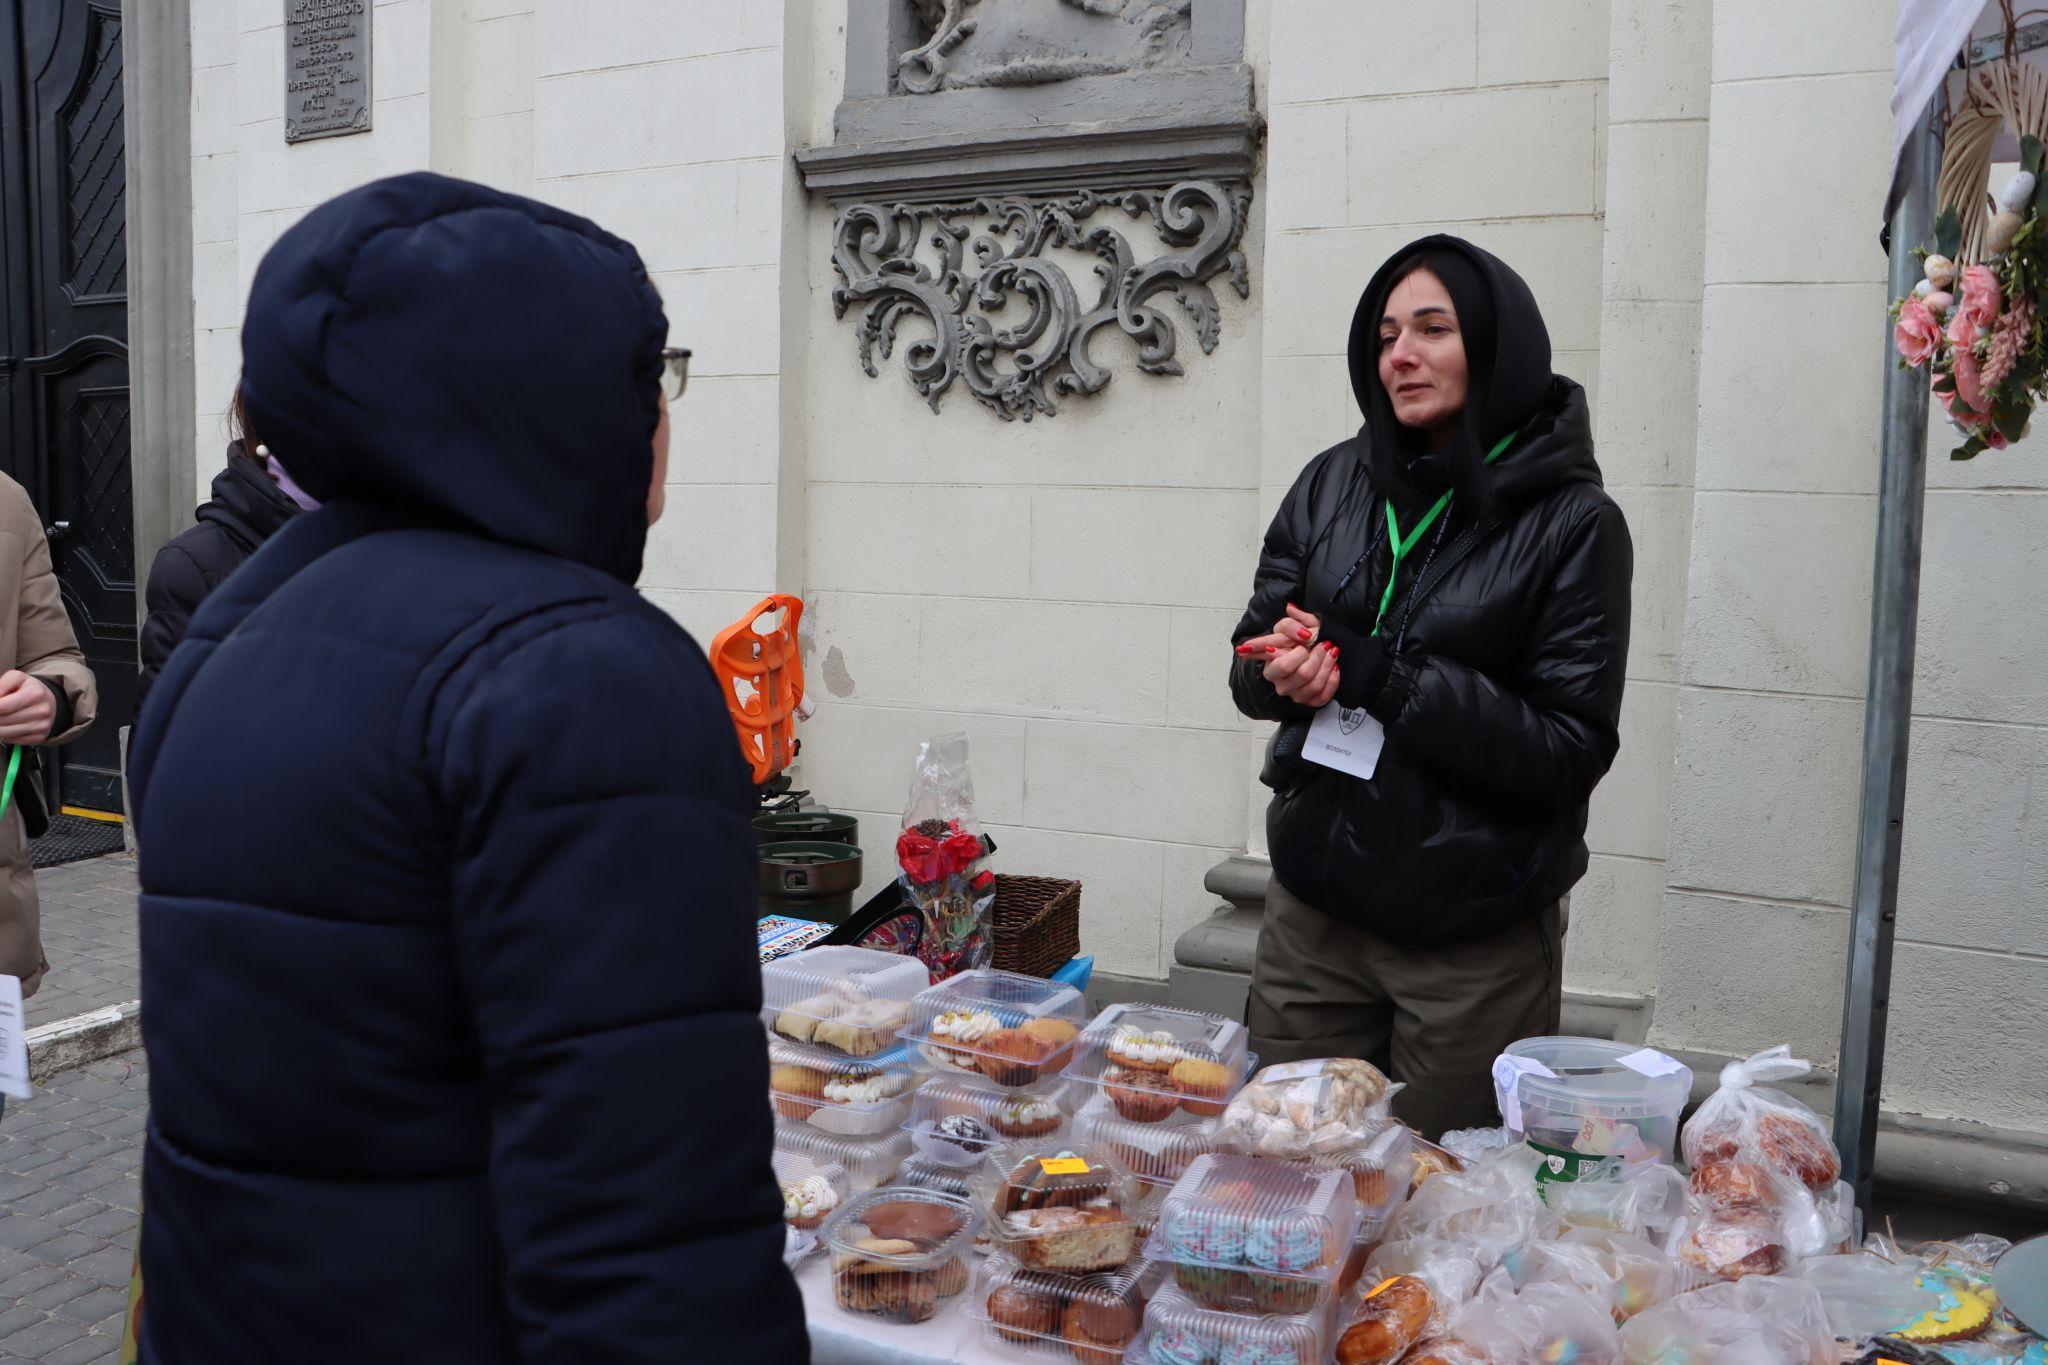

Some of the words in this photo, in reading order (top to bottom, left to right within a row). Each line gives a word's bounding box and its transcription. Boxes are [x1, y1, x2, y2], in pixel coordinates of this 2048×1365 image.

[287, 2, 364, 24] НАЦІОНАЛЬНОГО
[300, 16, 348, 33] ЗНАЧЕННЯ
[309, 44, 338, 55] СОБОР
[295, 51, 354, 69] НЕПОРОЧНОГО
[288, 76, 333, 92] ПРЕСВЯТОЇ
[1326, 743, 1353, 757] ВОЛОНТЕР
